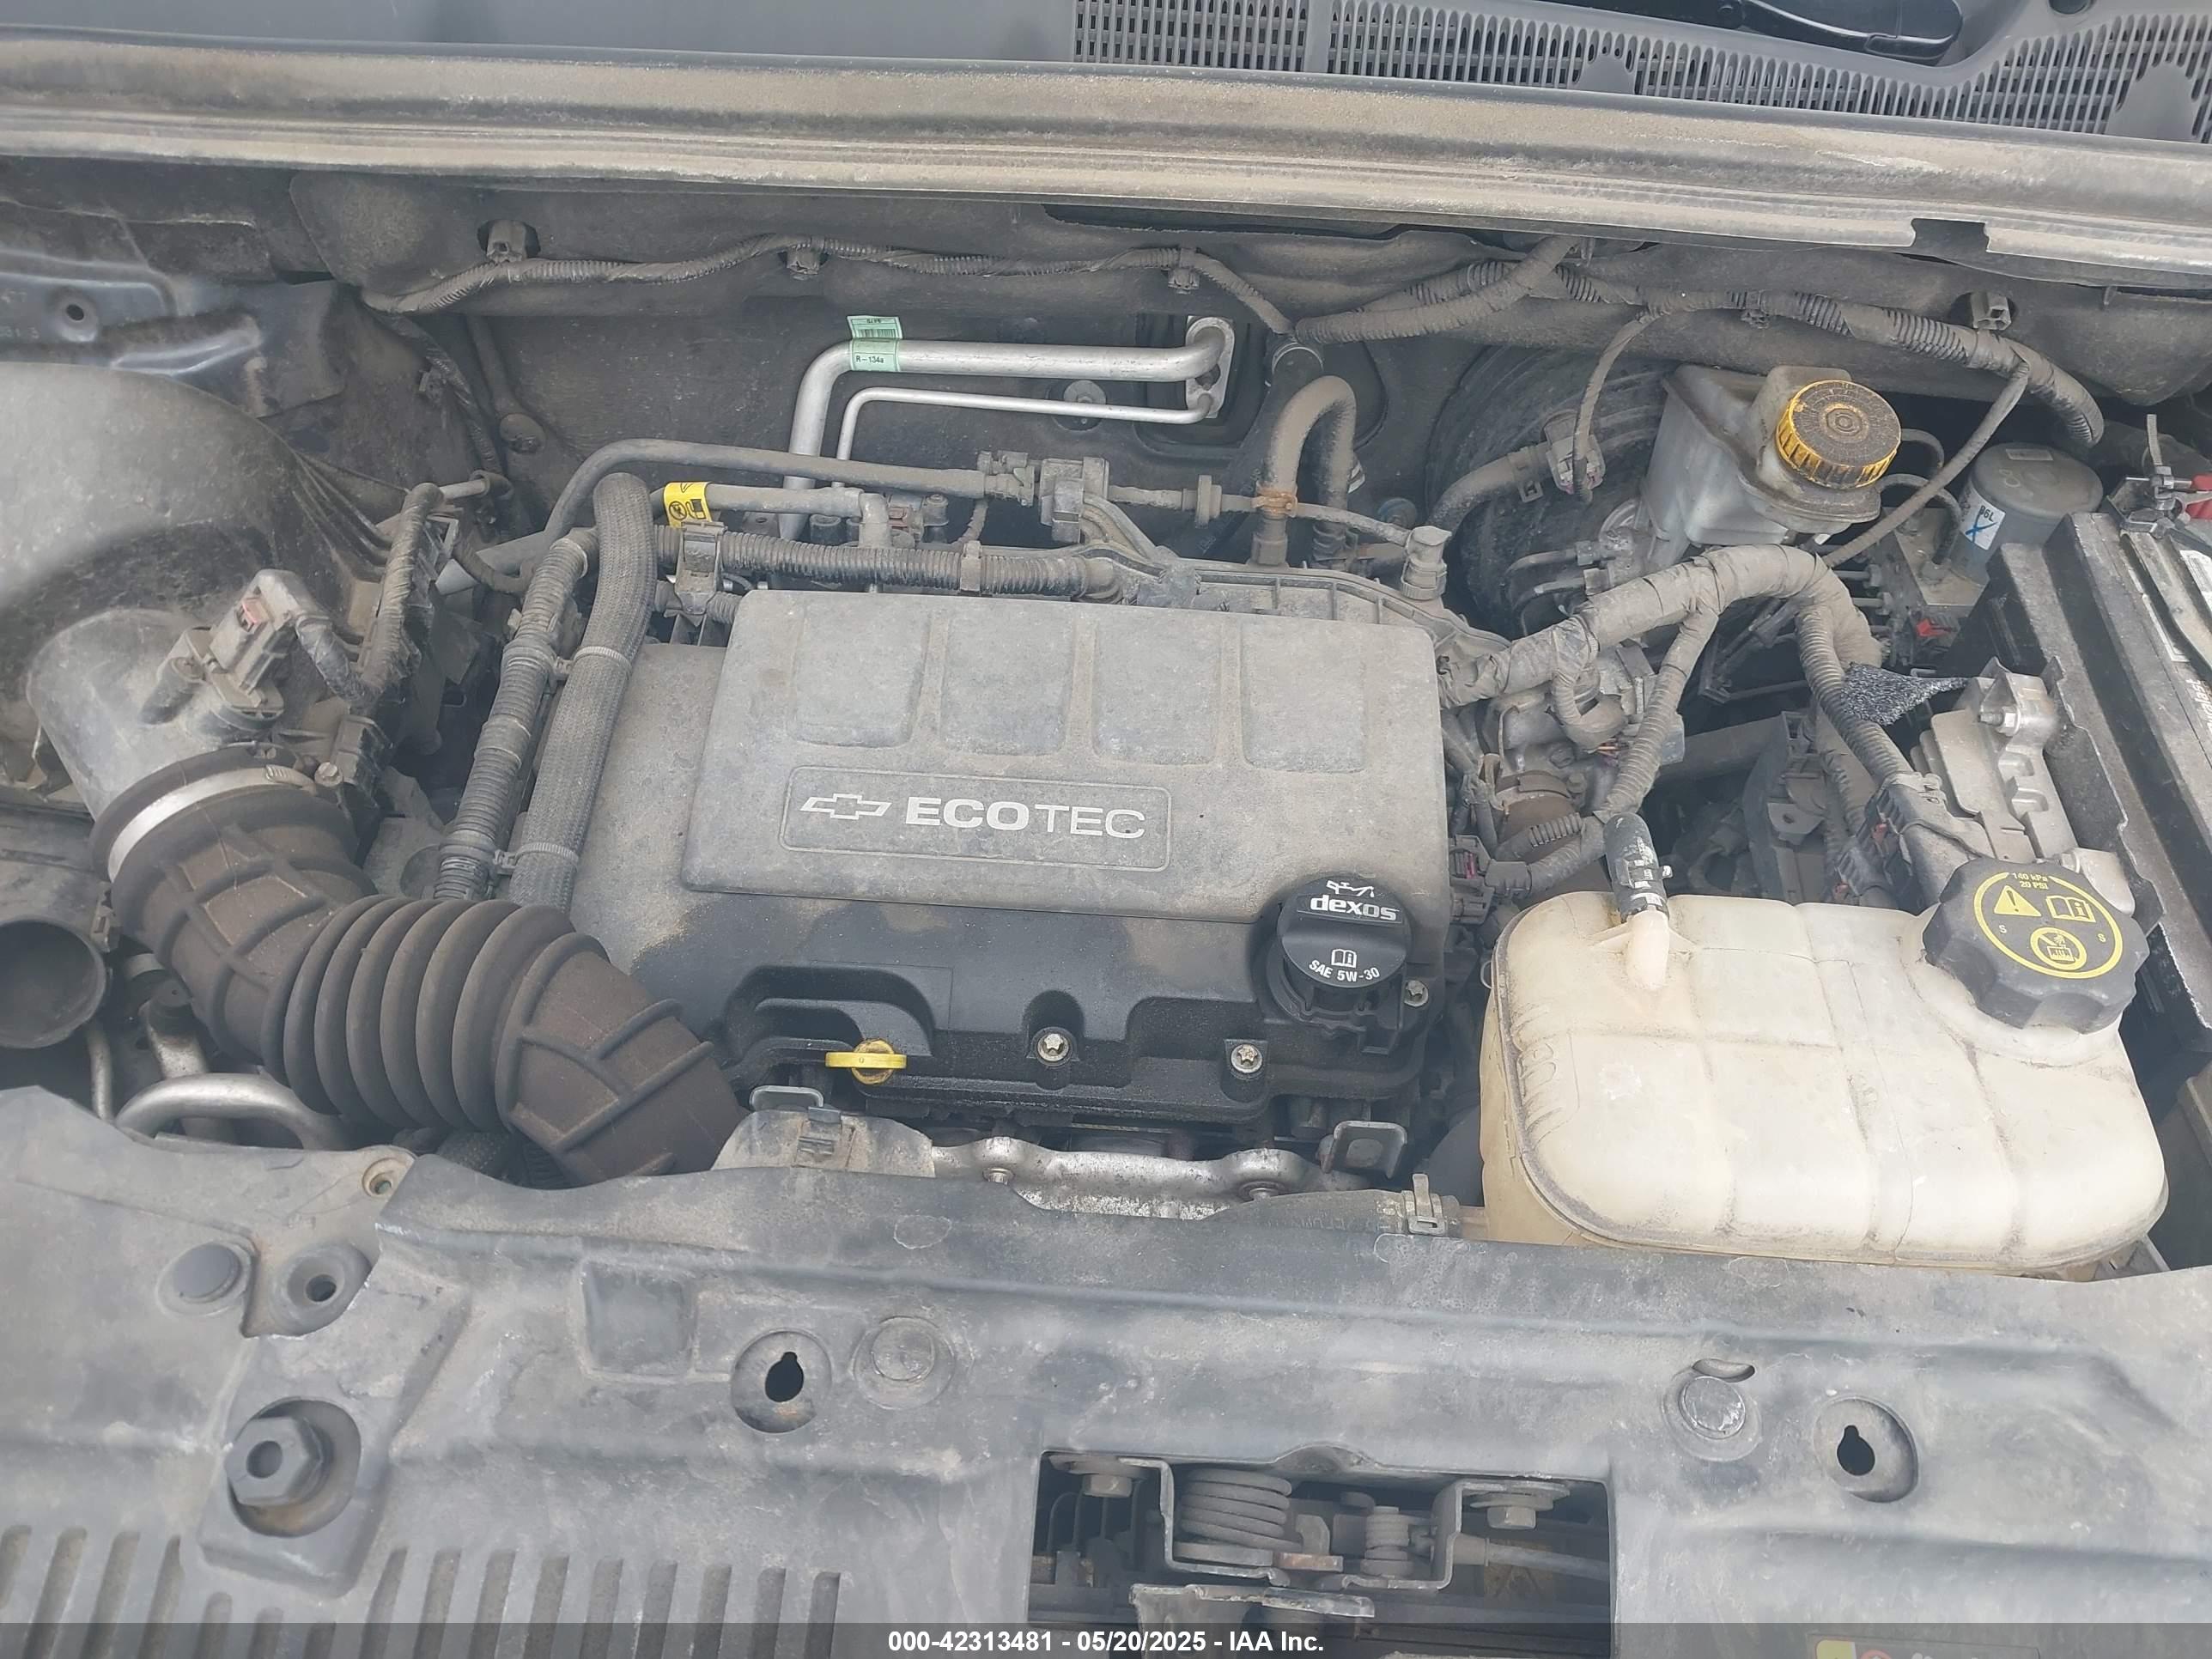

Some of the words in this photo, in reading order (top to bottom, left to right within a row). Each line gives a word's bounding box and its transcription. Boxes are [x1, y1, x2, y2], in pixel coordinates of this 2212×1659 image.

[905, 796, 1146, 839] ECOTEC
[1310, 894, 1400, 921] dexos
[1309, 959, 1333, 979] SAE
[1337, 967, 1380, 982] 5W-30
